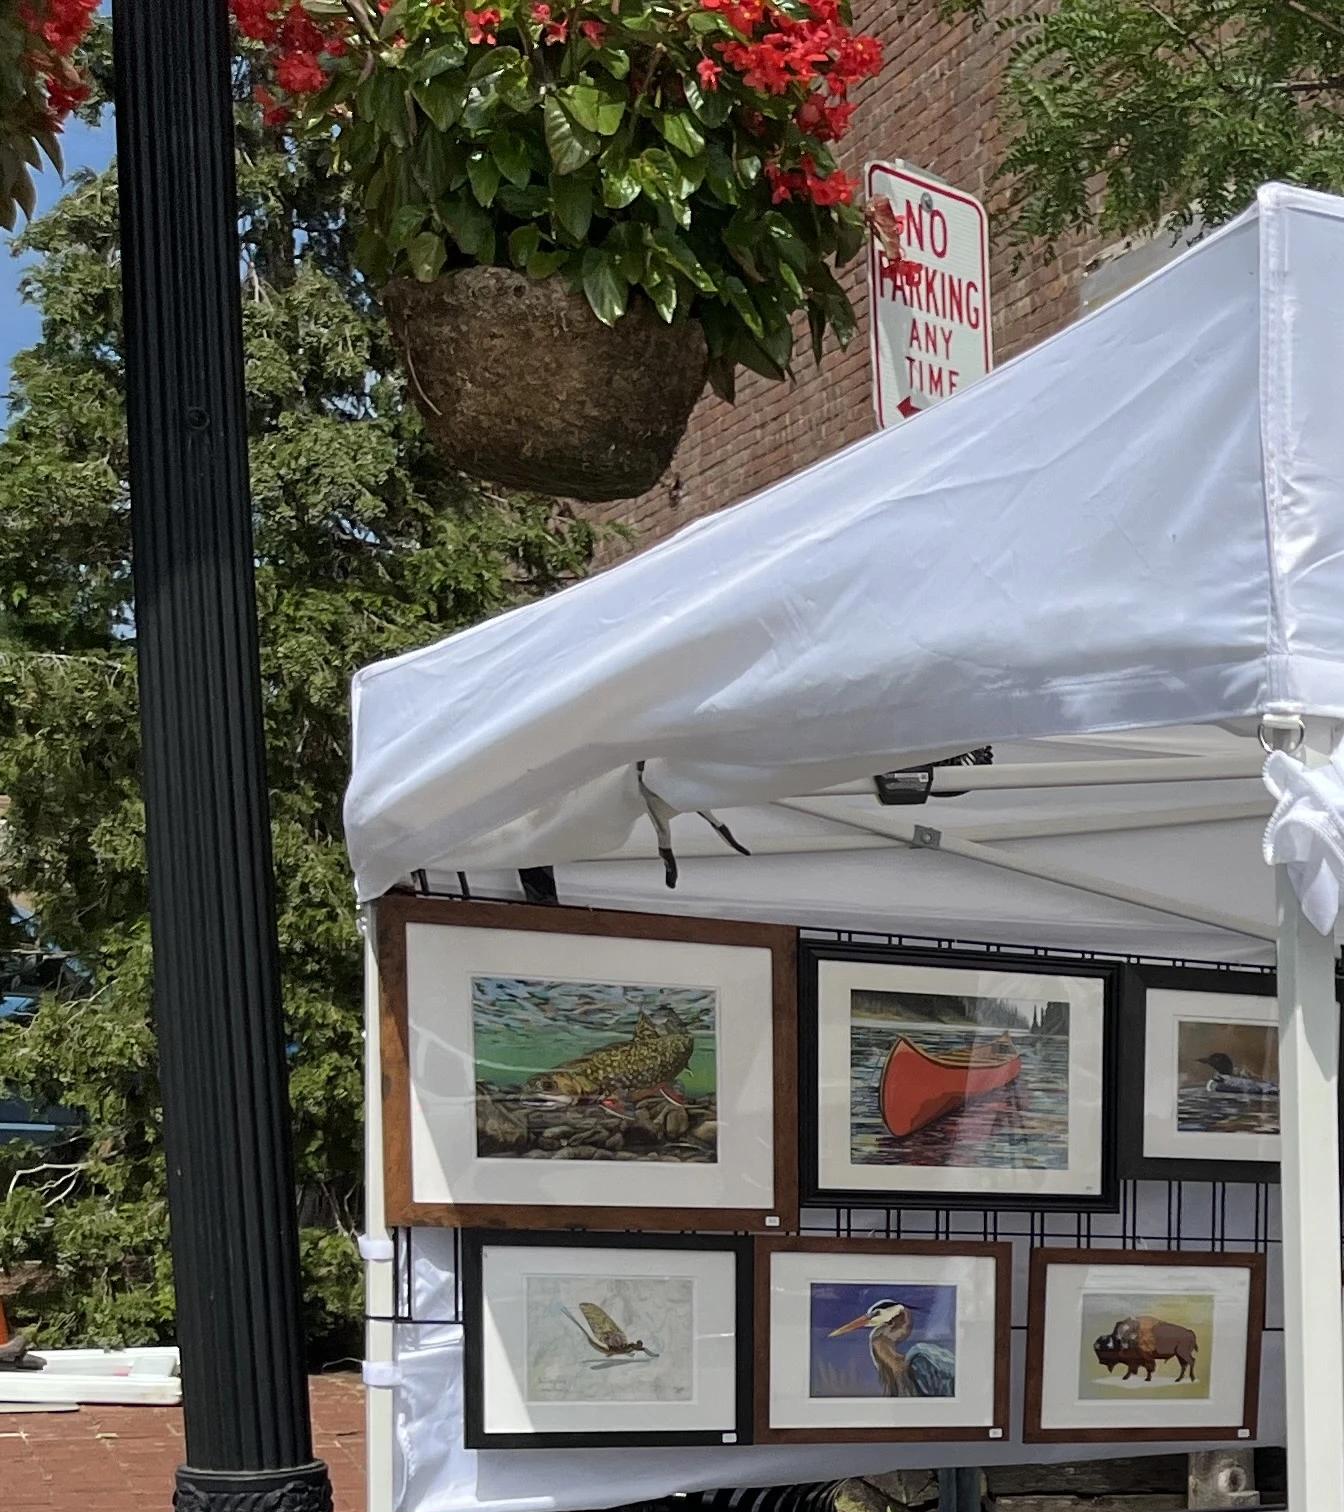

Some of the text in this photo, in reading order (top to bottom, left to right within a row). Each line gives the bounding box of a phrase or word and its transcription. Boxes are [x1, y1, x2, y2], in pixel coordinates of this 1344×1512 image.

[905, 199, 948, 259] NO
[878, 250, 980, 330] PARKING
[909, 318, 953, 360] ANY
[905, 356, 960, 398] TIME
